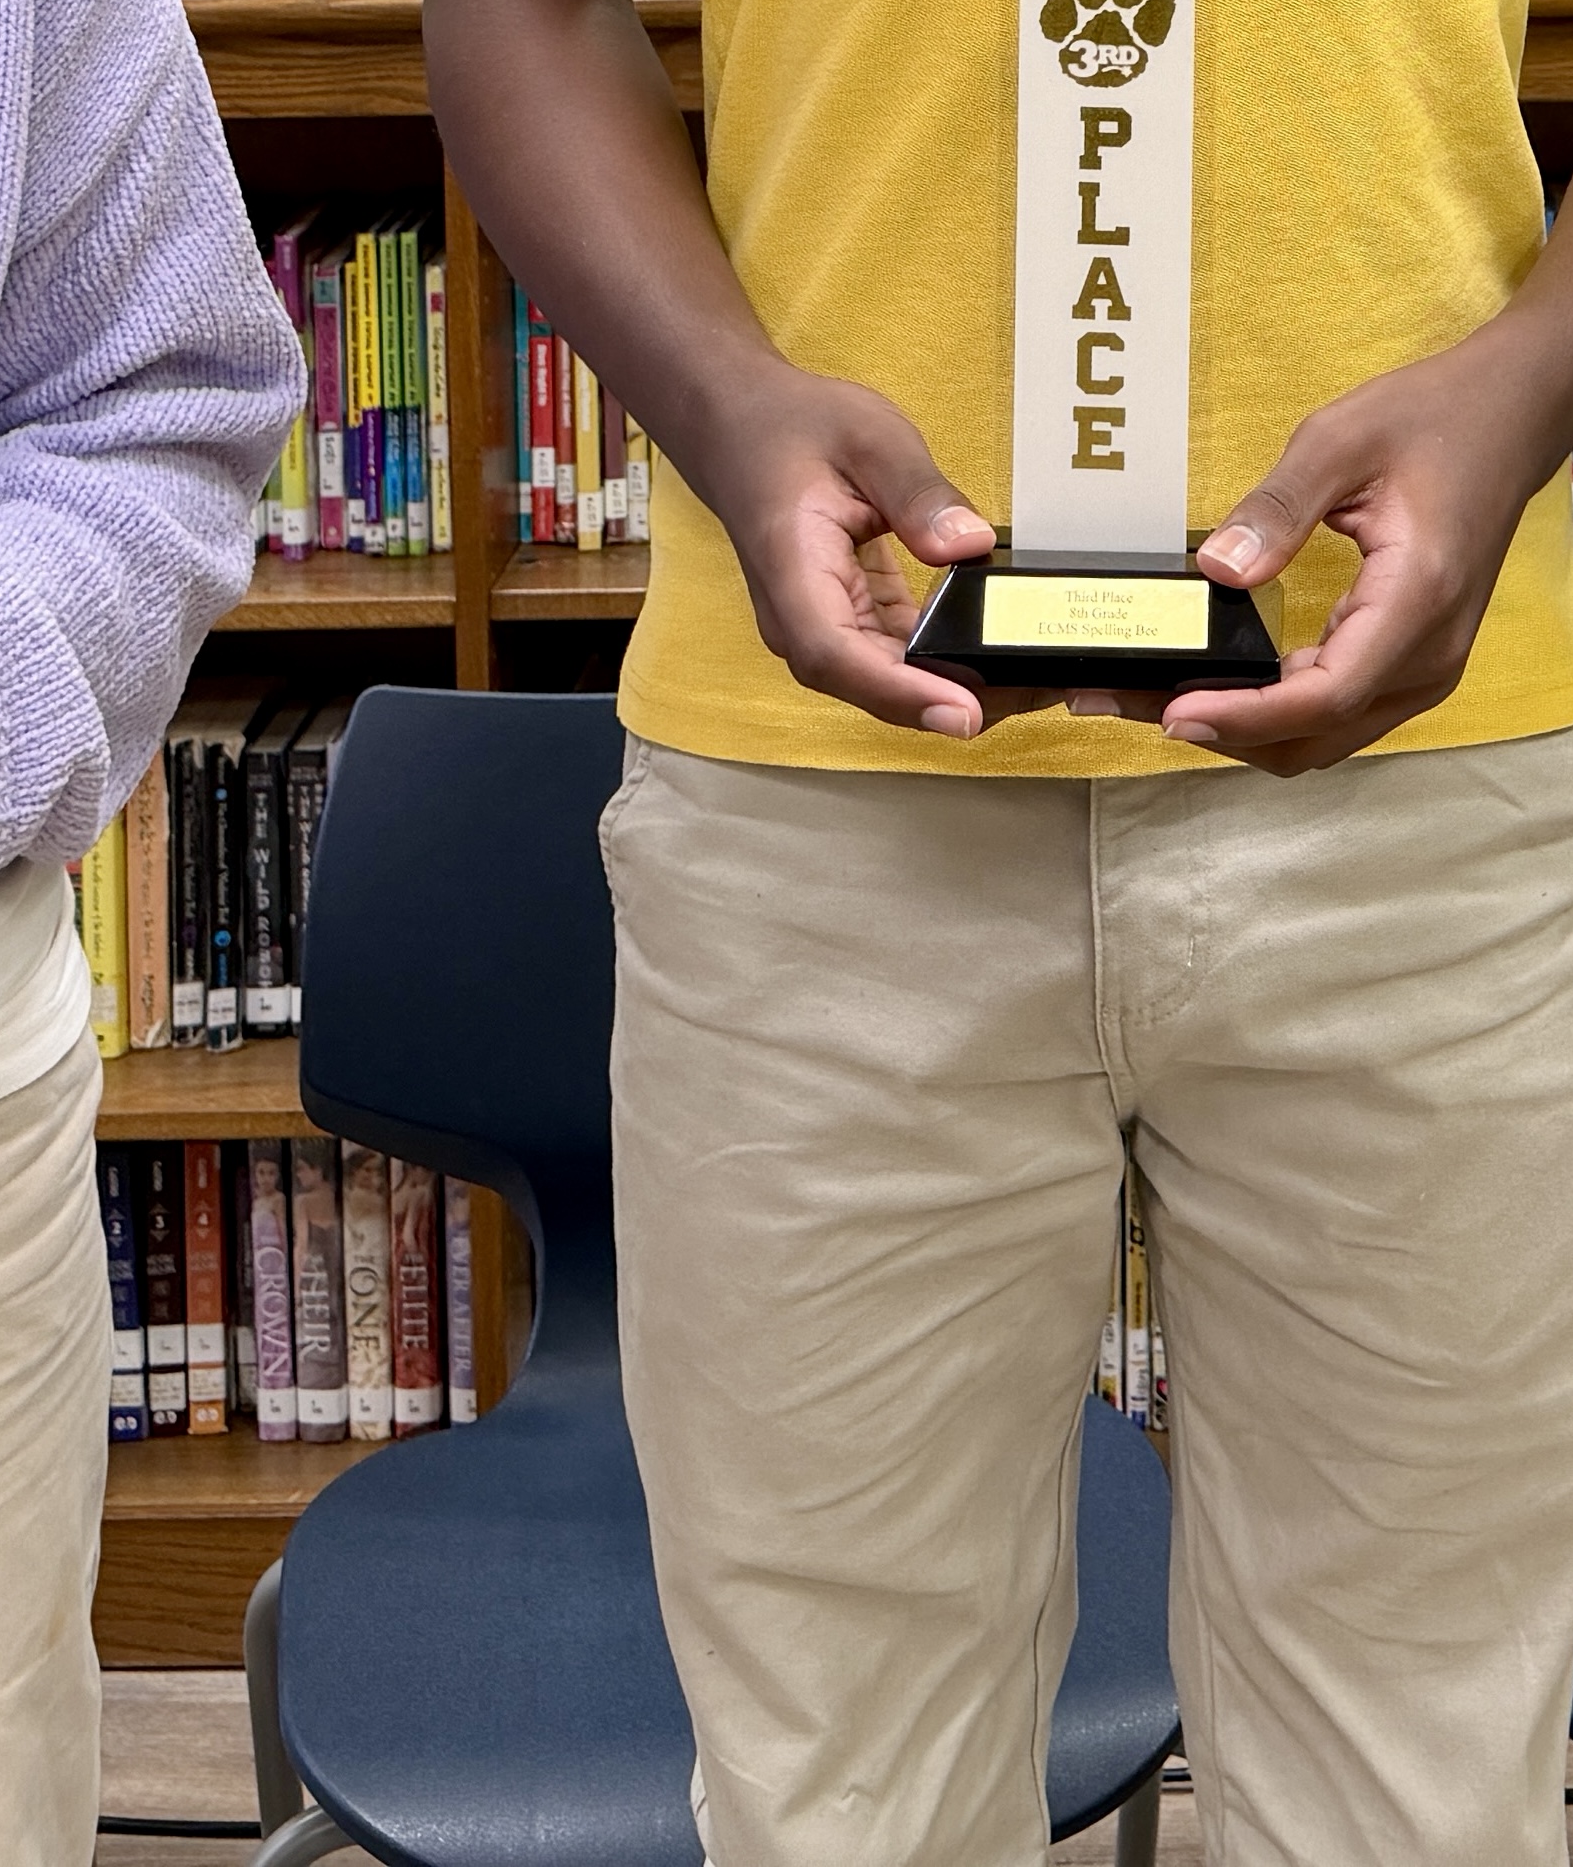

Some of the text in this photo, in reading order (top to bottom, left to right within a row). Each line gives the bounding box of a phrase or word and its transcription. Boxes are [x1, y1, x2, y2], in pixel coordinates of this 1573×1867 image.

[1067, 39, 1140, 78] 3RD
[1070, 106, 1133, 473] PLACE
[1065, 590, 1134, 605] Third Place
[1069, 607, 1128, 620] 8th Grade
[1038, 622, 1159, 639] ECMS Spelling Bee
[254, 792, 269, 839] THE
[254, 848, 271, 910] WILD
[257, 1246, 291, 1379] CROWN
[299, 1270, 330, 1364] HEIR
[349, 1265, 381, 1352] ONE
[399, 1265, 429, 1350] ELITE
